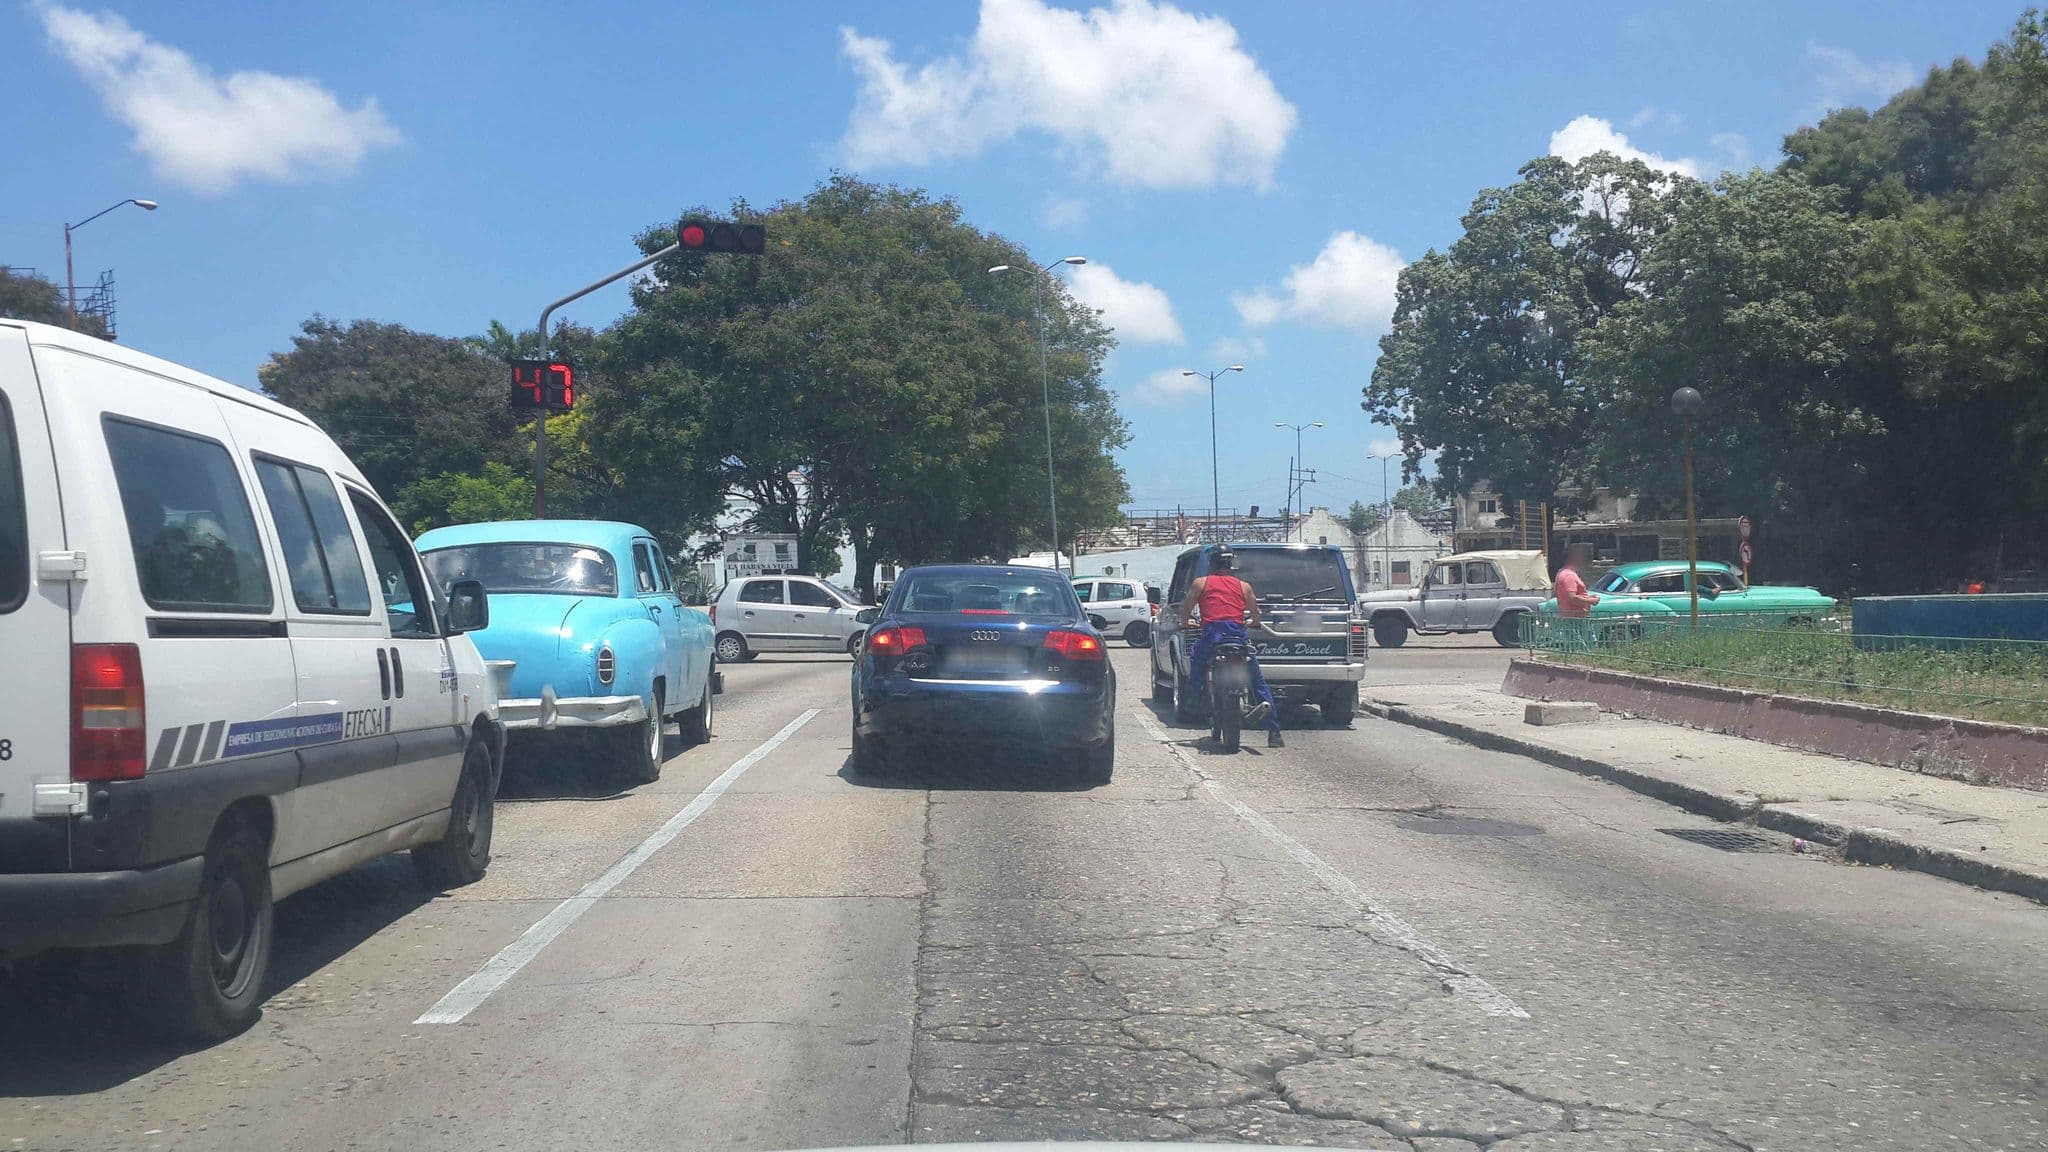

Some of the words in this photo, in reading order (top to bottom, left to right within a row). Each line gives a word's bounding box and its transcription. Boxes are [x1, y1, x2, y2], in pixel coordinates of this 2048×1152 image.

[514, 363, 573, 407] 47
[1256, 643, 1290, 655] Turbo
[1294, 643, 1332, 655] Diesel
[344, 708, 383, 739] ETECSA
[228, 732, 254, 747] EMPRESA
